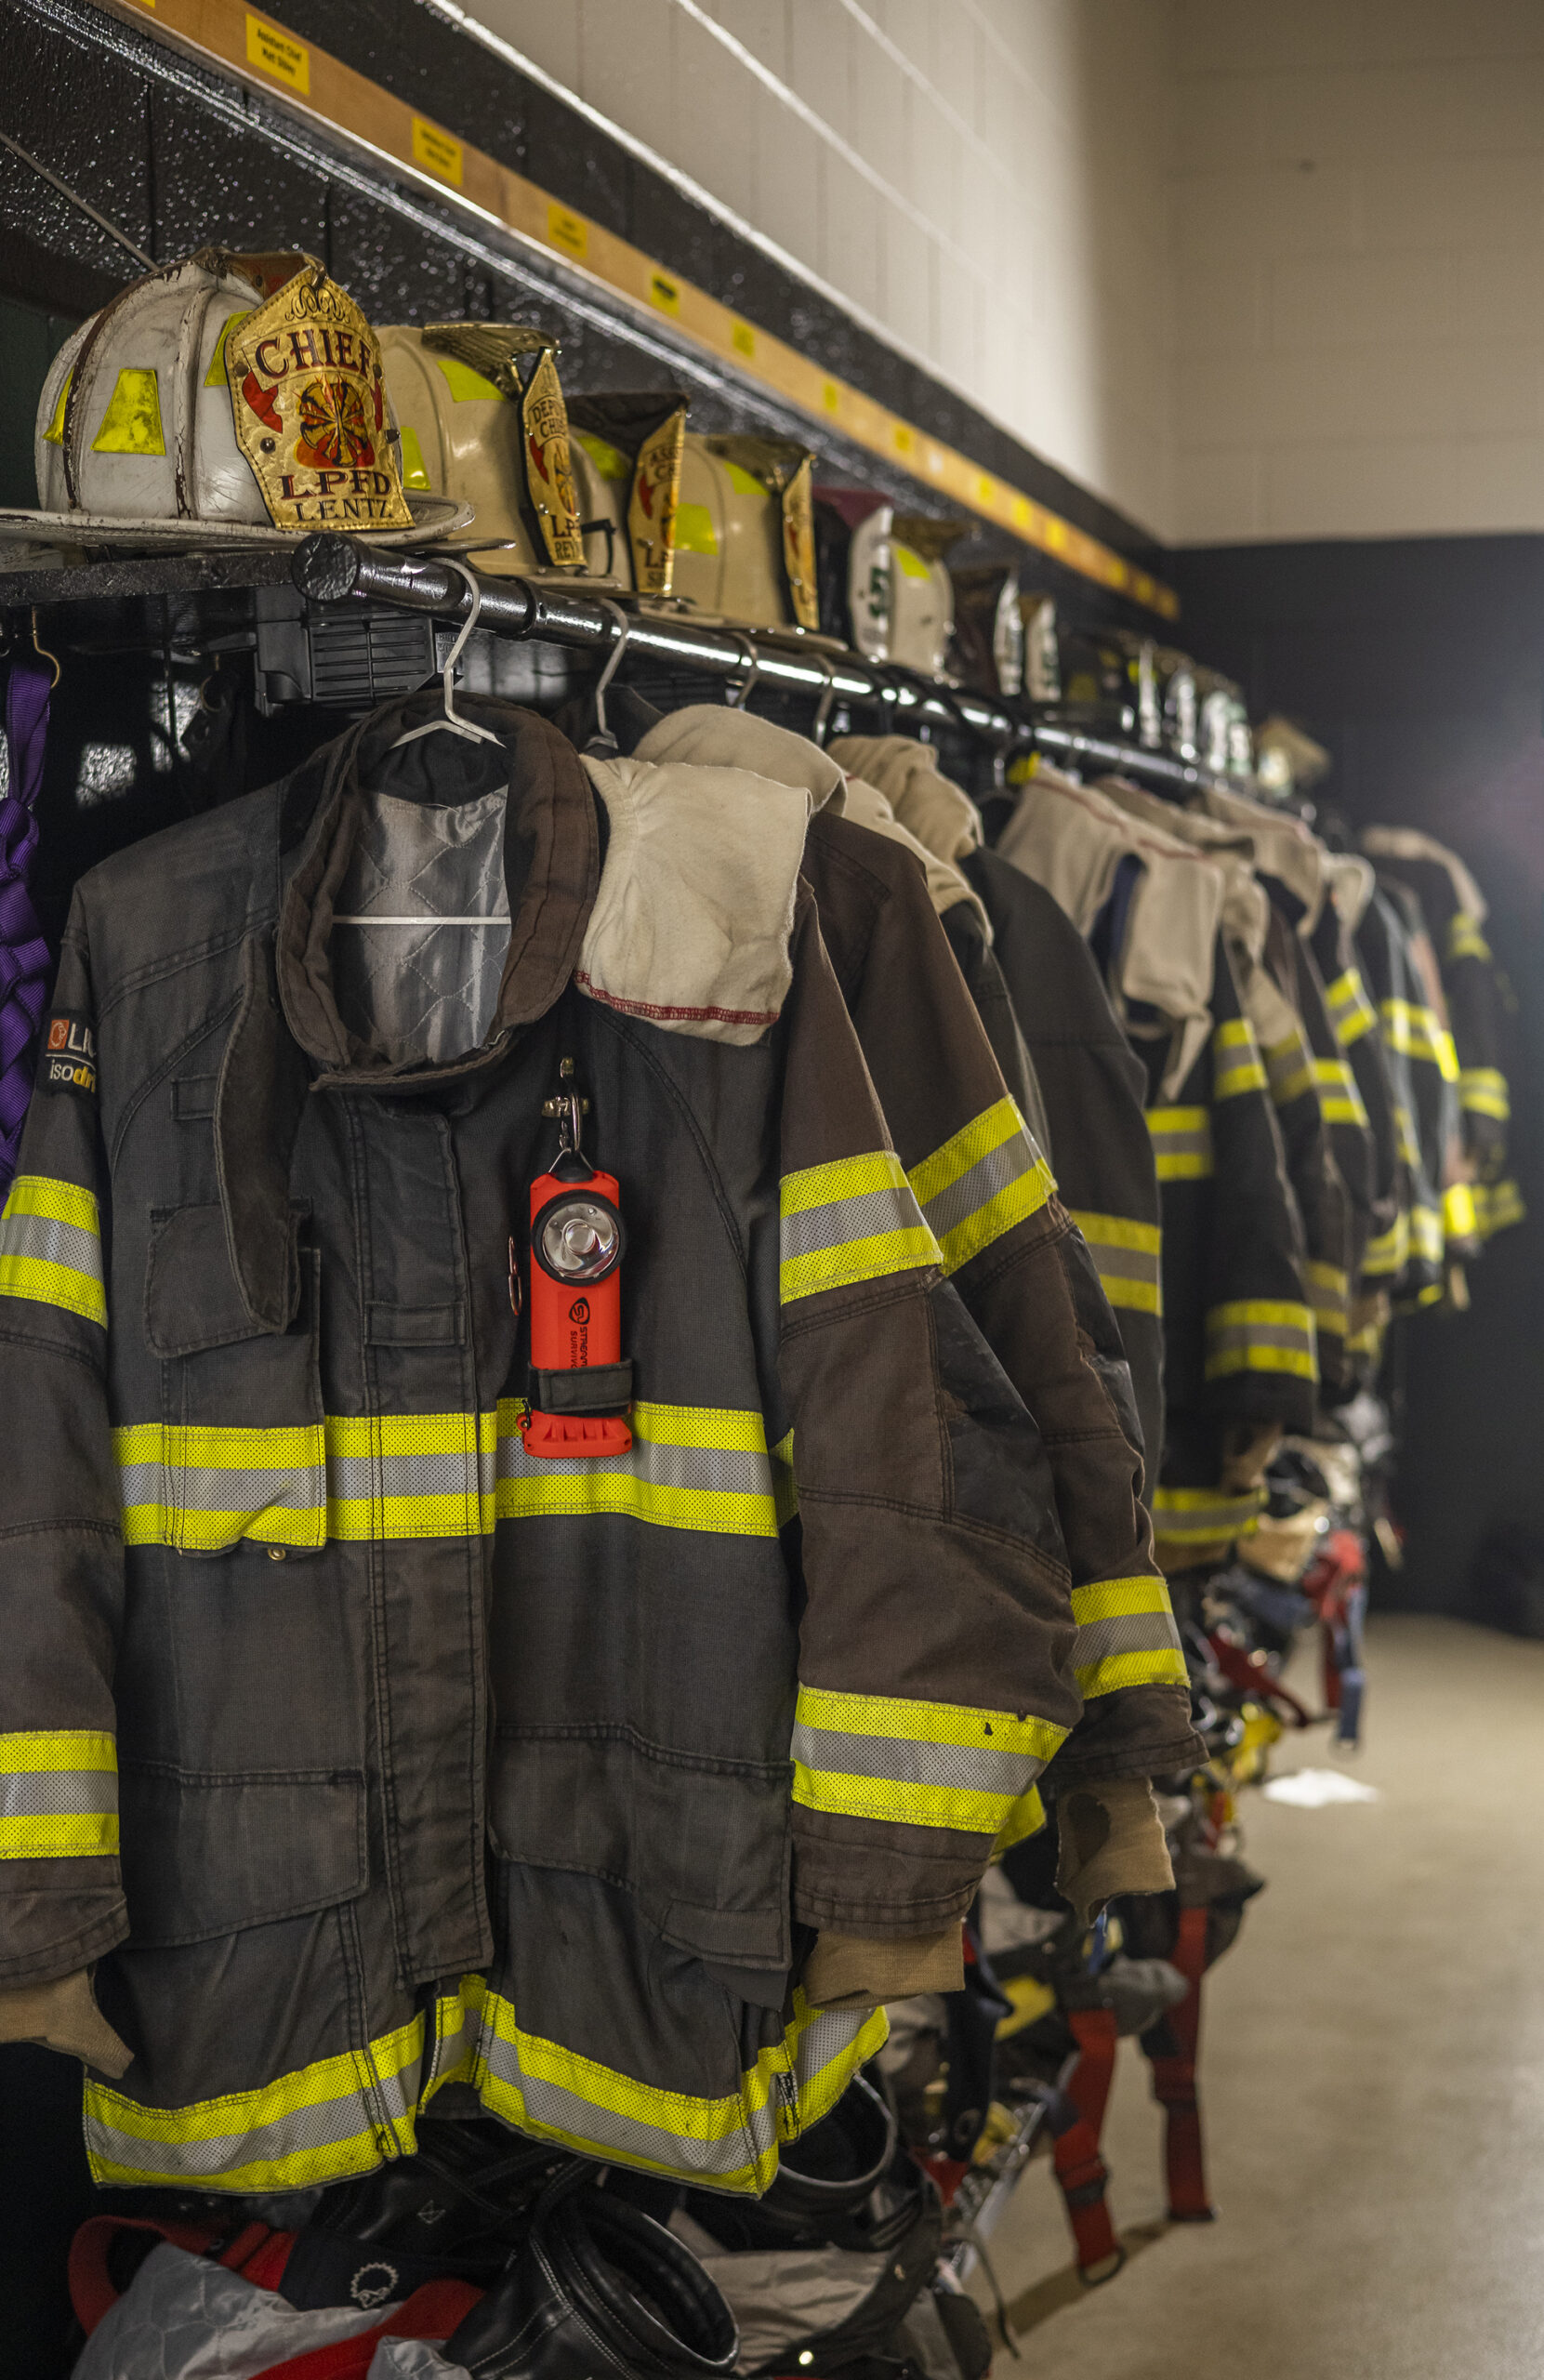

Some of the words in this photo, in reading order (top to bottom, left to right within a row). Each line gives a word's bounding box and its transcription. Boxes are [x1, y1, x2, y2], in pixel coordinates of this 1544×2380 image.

[255, 328, 372, 379] CHIEF
[280, 469, 391, 500] LPFD
[295, 499, 394, 522] LENTZ
